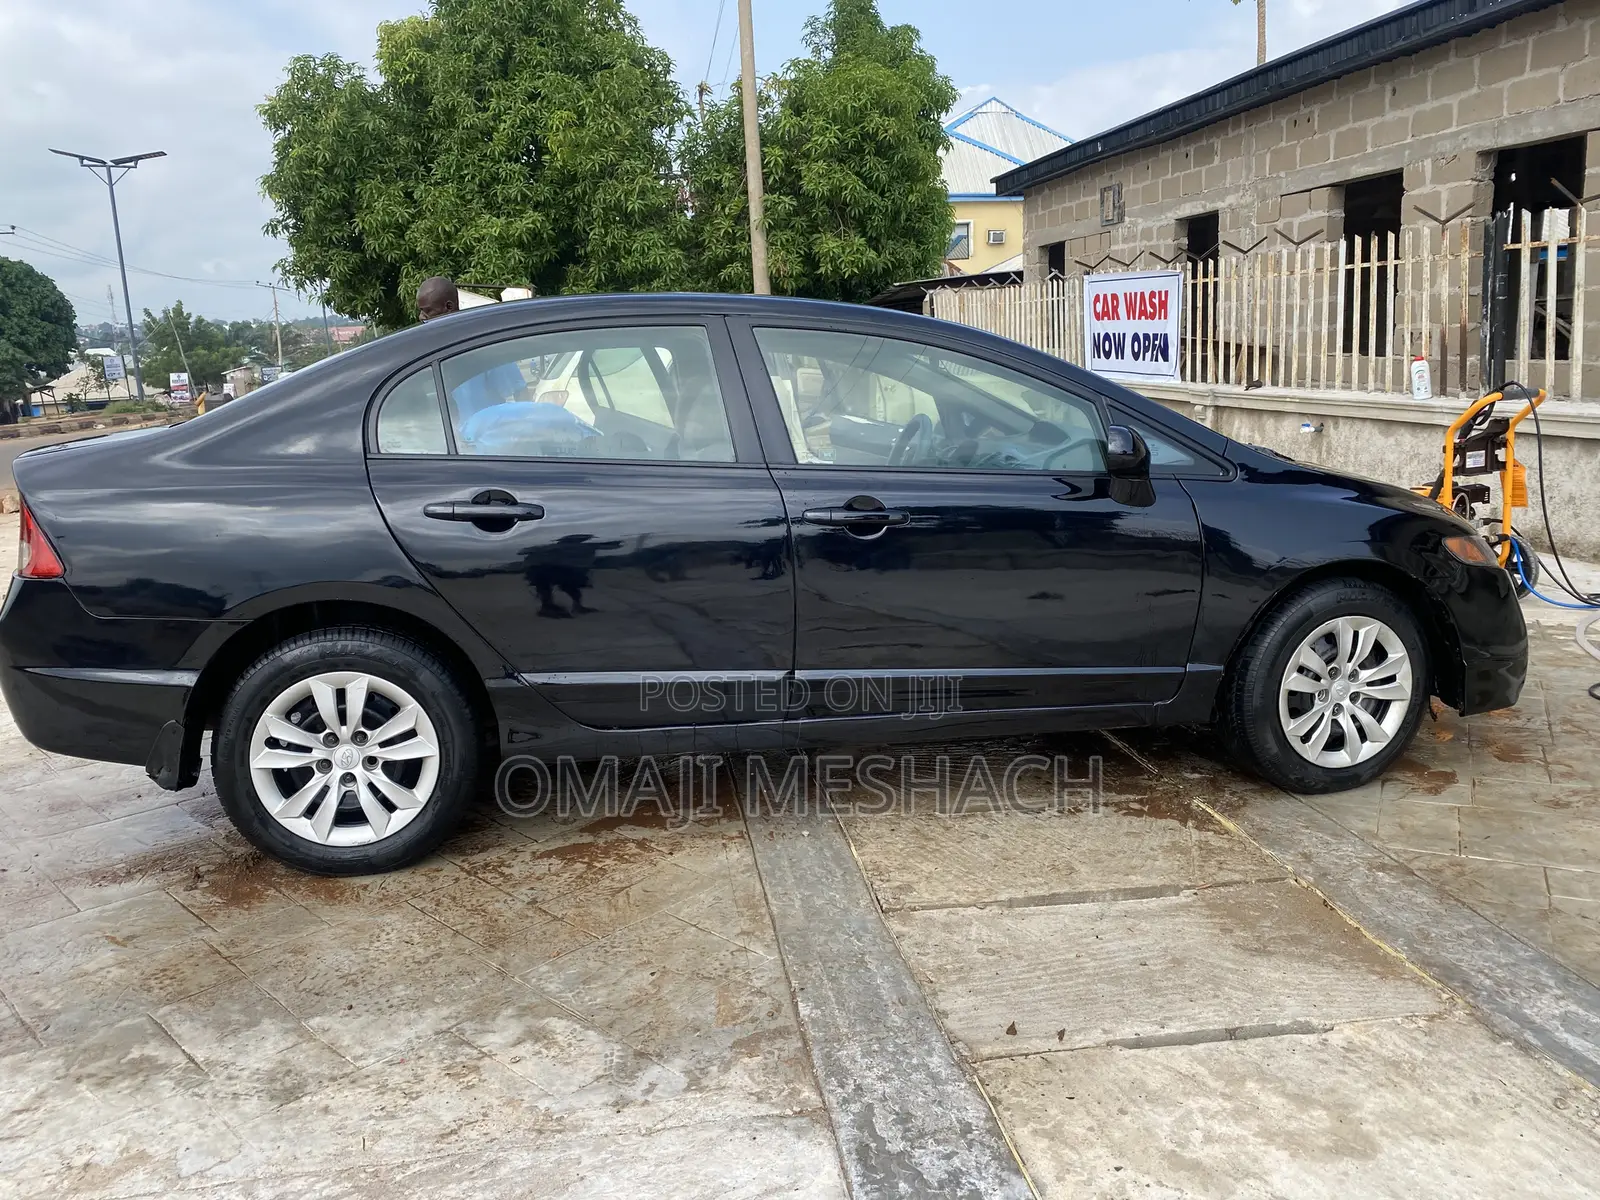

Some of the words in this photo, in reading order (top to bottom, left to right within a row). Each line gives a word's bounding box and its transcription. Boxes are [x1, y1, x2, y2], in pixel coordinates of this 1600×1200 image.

[1093, 293, 1121, 321] CAR
[1123, 290, 1169, 321] WASH
[1092, 332, 1126, 360] NOW
[1131, 332, 1170, 362] OPEN
